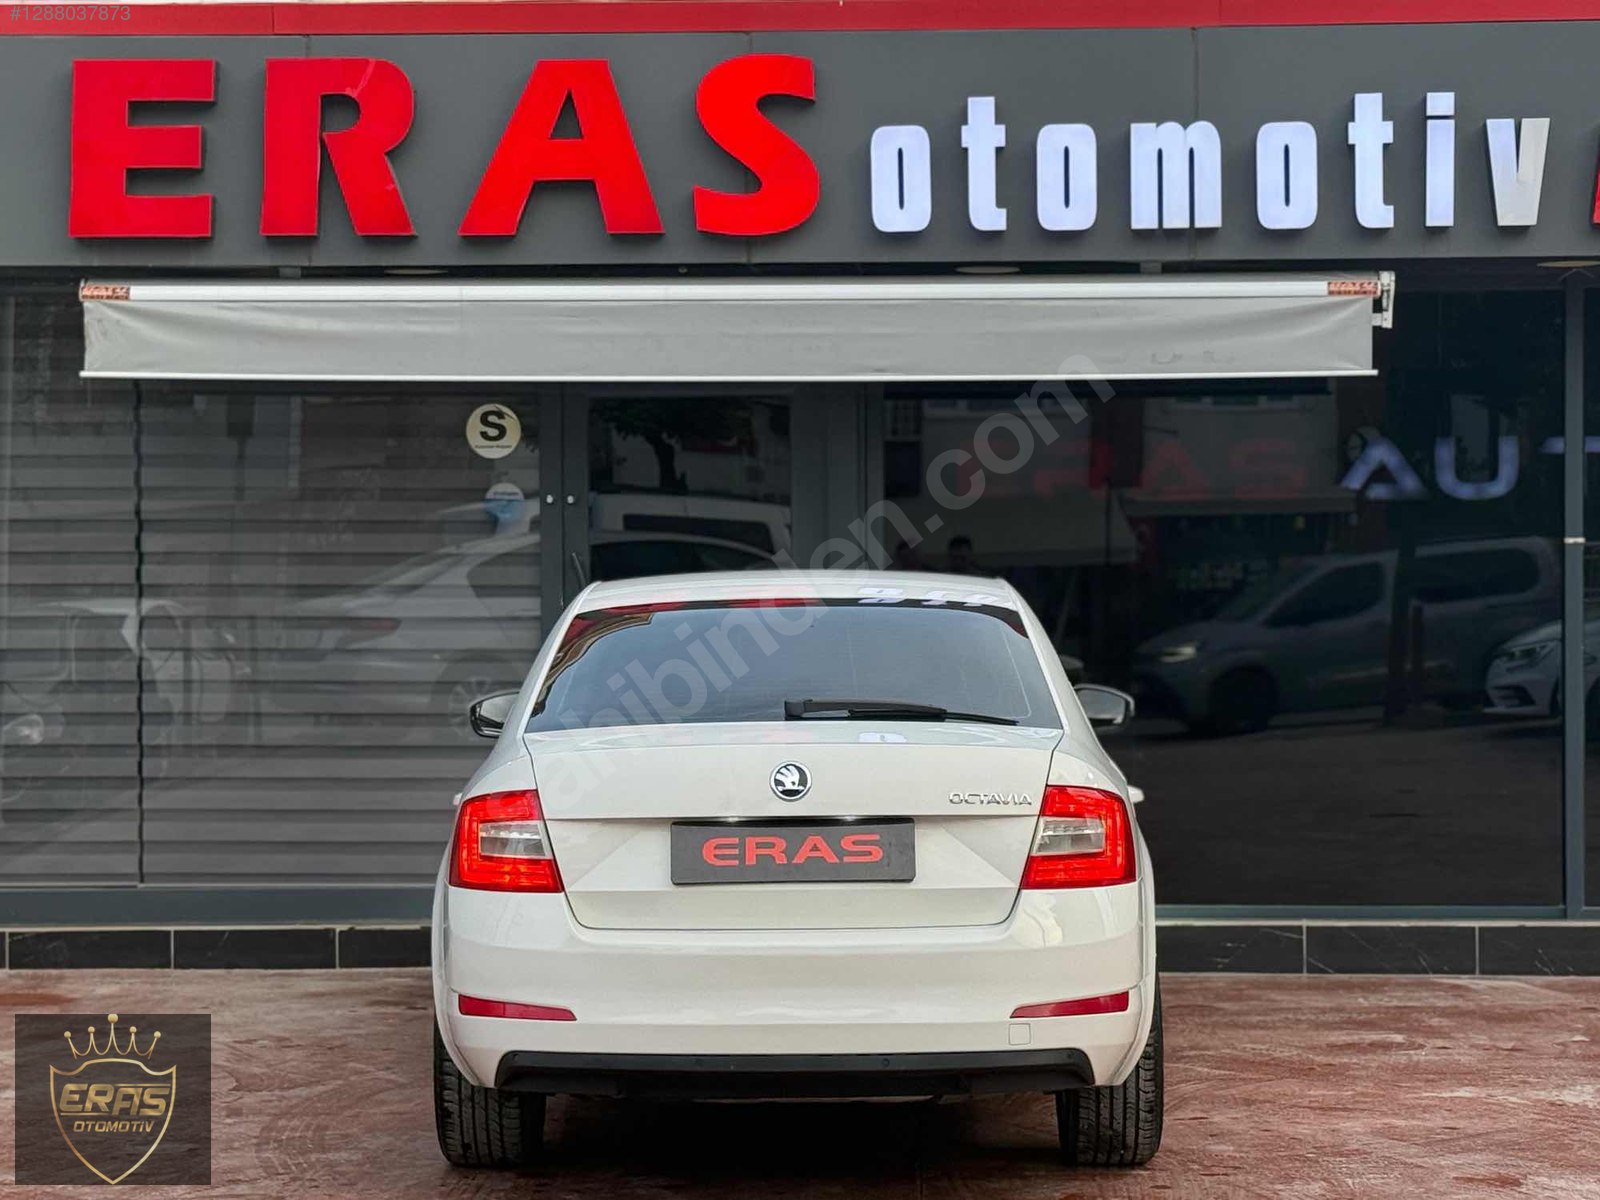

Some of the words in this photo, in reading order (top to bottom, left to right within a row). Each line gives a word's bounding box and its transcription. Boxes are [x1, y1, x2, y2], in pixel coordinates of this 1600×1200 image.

[68, 53, 821, 239] ERAS
[869, 91, 1550, 234] otomotiv
[480, 410, 507, 442] S
[949, 792, 1033, 806] OCTAVIA
[702, 834, 884, 867] ERAS
